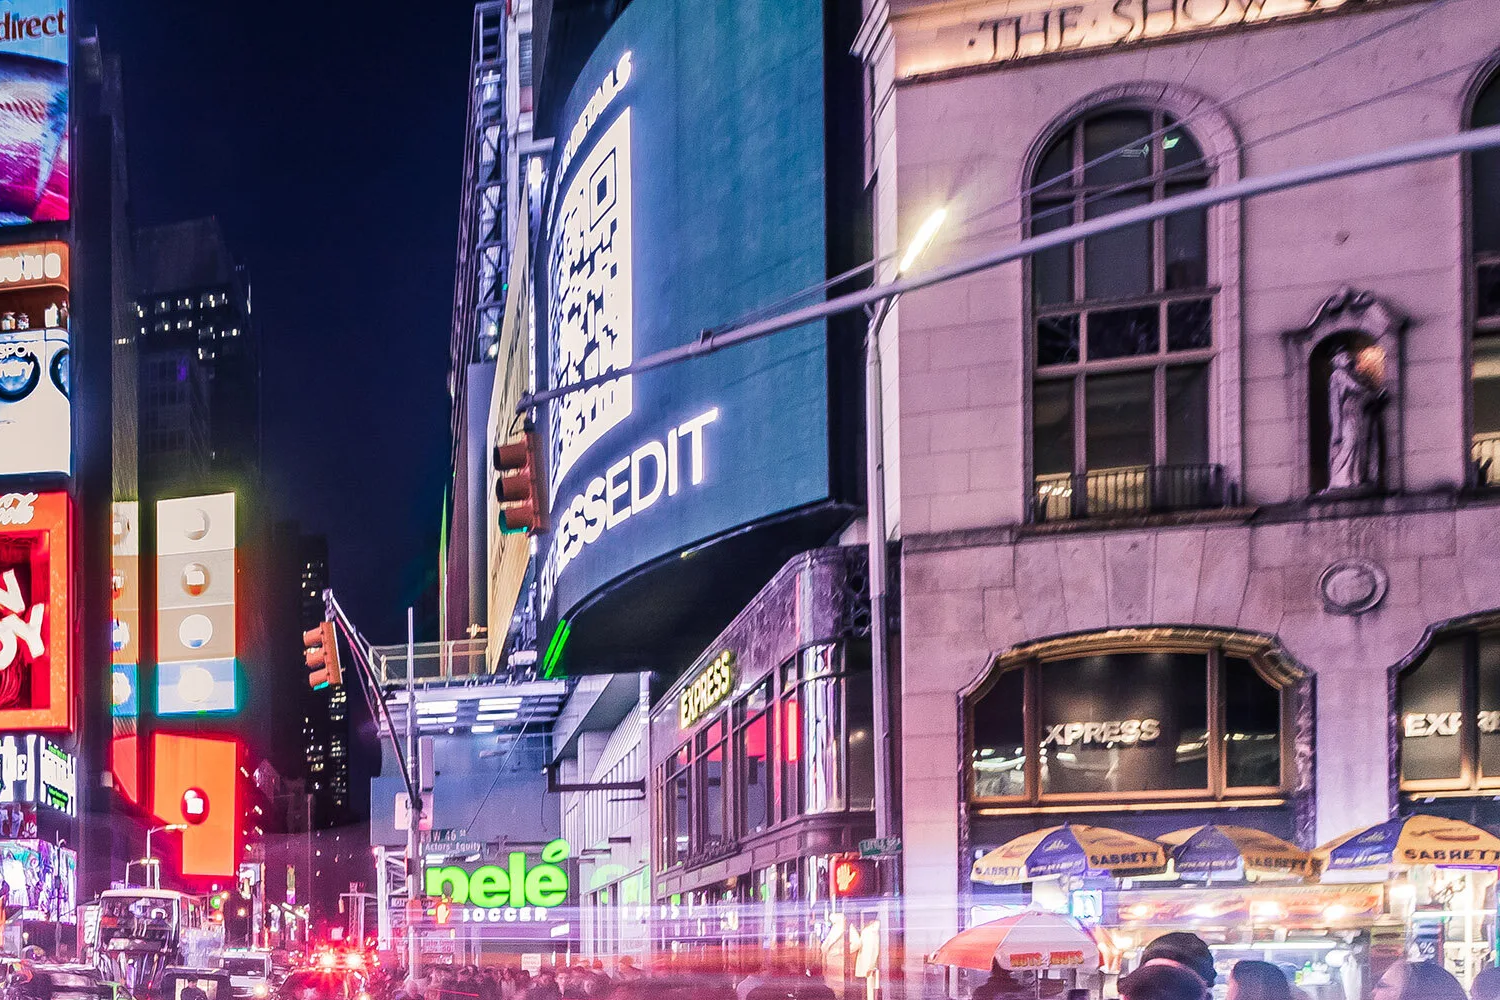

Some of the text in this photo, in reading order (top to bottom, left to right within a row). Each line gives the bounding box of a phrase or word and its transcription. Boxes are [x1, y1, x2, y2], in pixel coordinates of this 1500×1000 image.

[980, 6, 1085, 62] THE
[681, 650, 731, 730] EXPRESS
[445, 829, 457, 842] 46
[455, 841, 481, 853] Equity
[1089, 851, 1158, 867] SABRETT
